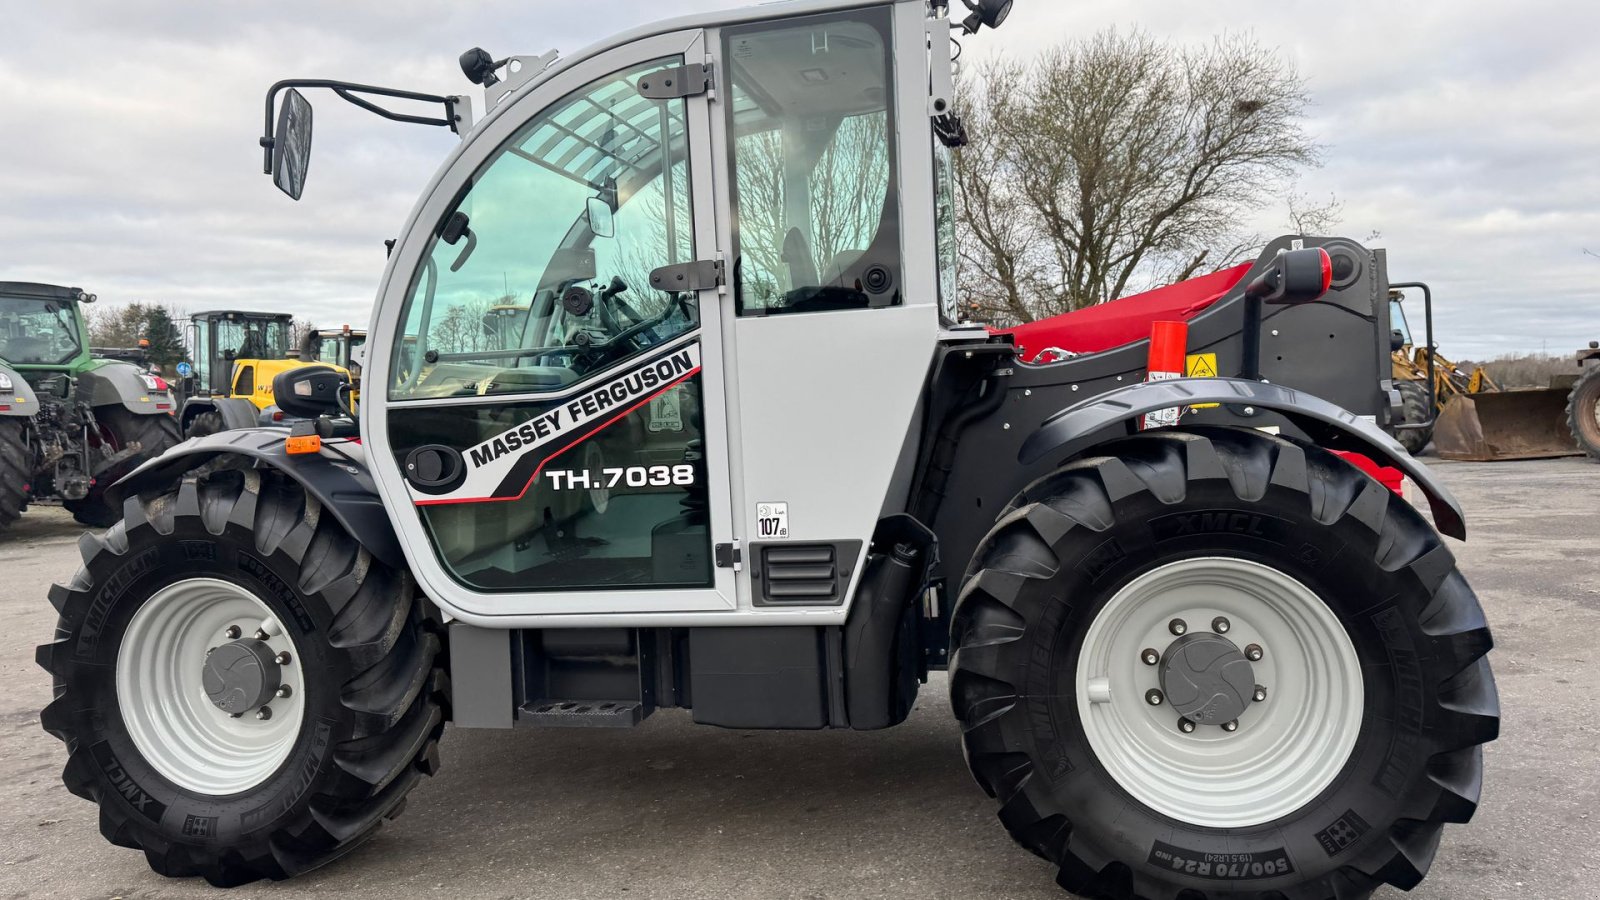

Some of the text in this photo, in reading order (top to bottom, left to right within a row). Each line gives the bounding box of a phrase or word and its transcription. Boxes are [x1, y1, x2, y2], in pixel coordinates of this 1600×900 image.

[469, 351, 694, 468] MASSEY FERGUSON
[545, 464, 695, 491] TH.7038
[759, 517, 787, 536] 107 dB
[1175, 512, 1264, 535] XMCL
[87, 550, 158, 632] MICHELIN
[103, 757, 153, 813] XMCL
[242, 752, 321, 832] MICHIN
[1154, 850, 1289, 877] 500/70 R24 IND
